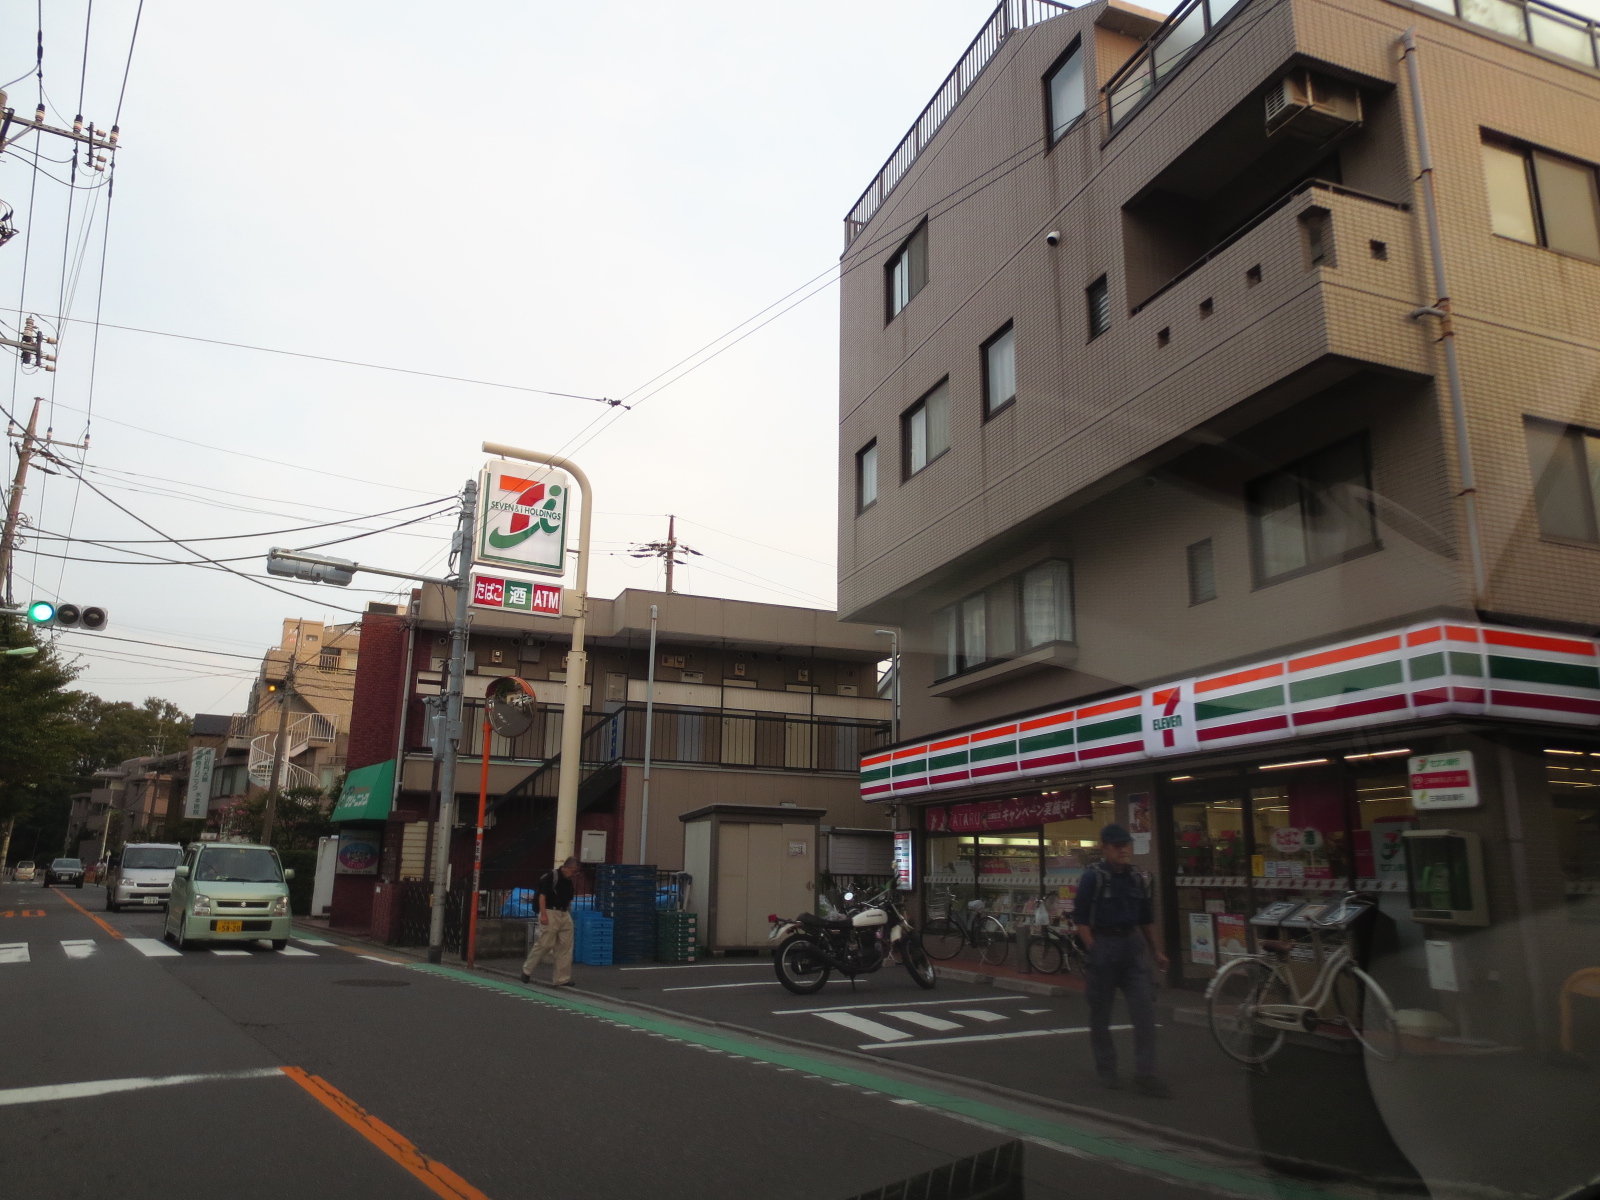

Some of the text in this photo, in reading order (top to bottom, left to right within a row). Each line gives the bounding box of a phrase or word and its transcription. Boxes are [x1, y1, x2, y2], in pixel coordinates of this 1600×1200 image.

[491, 500, 515, 512] SEVEN
[525, 508, 561, 521] HOLDINGS
[475, 582, 502, 601] たばこ
[509, 586, 527, 605] 酒
[533, 589, 559, 609] ATM
[952, 811, 980, 827] ATARU
